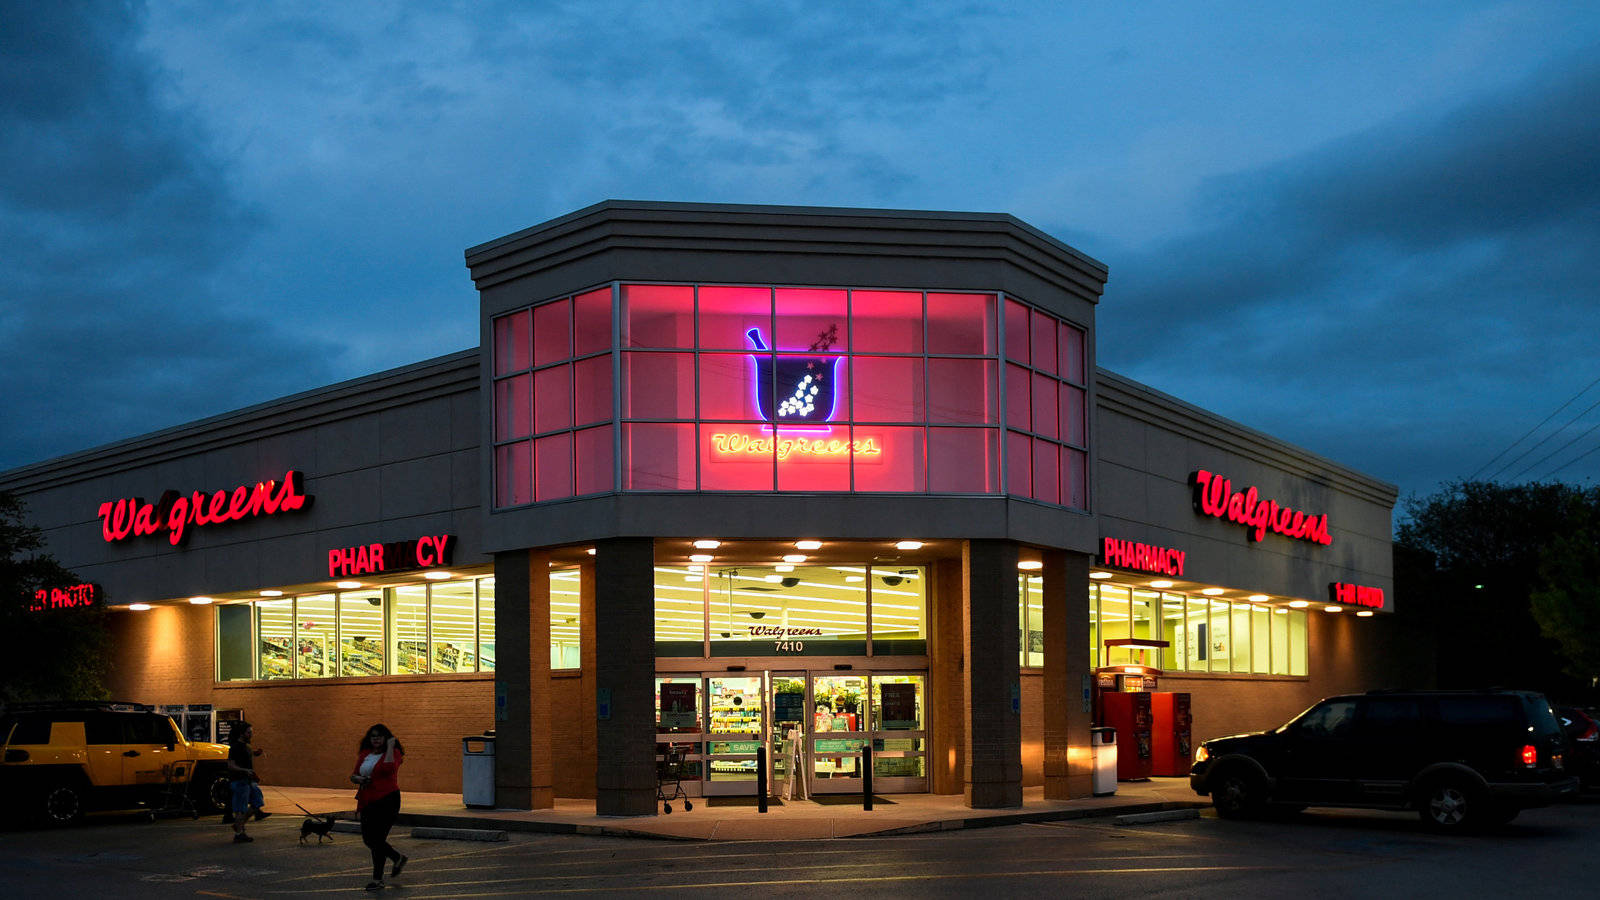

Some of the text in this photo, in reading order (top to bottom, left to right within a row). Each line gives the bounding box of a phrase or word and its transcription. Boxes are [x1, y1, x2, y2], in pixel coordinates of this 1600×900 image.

[712, 433, 880, 460] Walgreens
[97, 470, 306, 546] Walgreens
[1196, 469, 1333, 546] Walgreens
[1104, 536, 1186, 577] PHARMACY
[748, 625, 823, 639] Walgreens
[774, 641, 804, 652] 7410
[733, 743, 756, 751] SAVE
